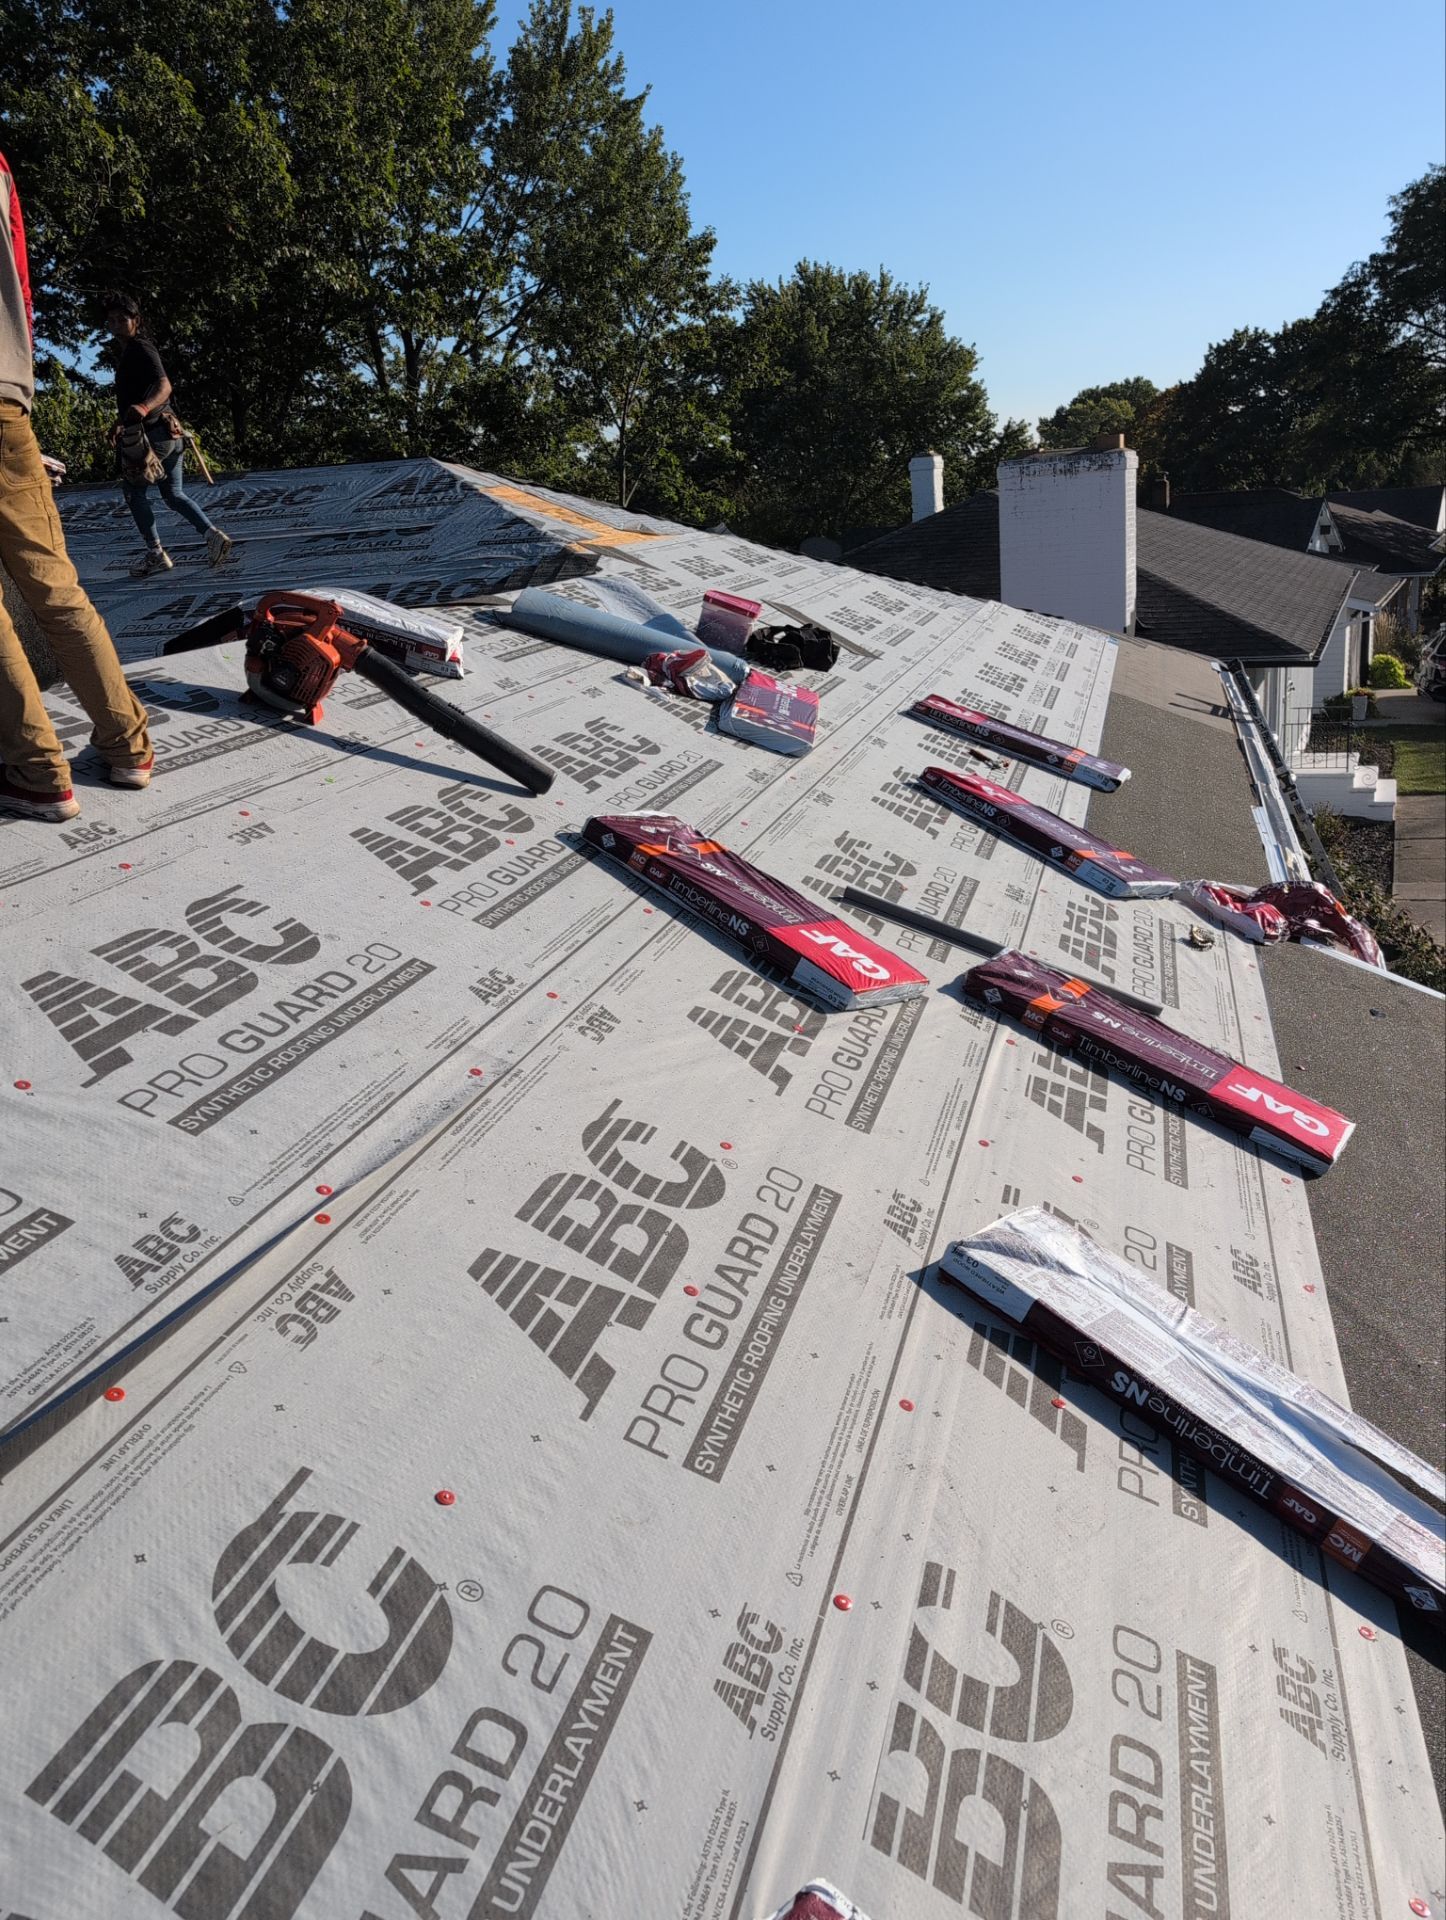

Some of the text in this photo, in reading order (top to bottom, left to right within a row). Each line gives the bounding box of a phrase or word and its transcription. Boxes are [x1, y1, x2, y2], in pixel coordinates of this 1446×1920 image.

[531, 716, 661, 794] ABC
[606, 750, 704, 809] PRO GUARD 20
[58, 820, 118, 850] ABC
[227, 821, 276, 847] ABC
[349, 780, 534, 896] ABC
[630, 851, 647, 865] MC
[437, 838, 566, 916] PRO GUARD
[479, 893, 528, 928] SYNTHETIC
[524, 869, 559, 902] ROOFING
[801, 830, 917, 937] ABC
[799, 928, 892, 980] GAF
[1059, 894, 1119, 984] ABC
[20, 884, 321, 1089] ABC
[467, 967, 517, 1006] ABC
[1022, 1007, 1045, 1025] MC
[117, 1053, 228, 1117] PRO
[217, 971, 357, 1054] GUARD
[346, 942, 402, 974] 20
[177, 960, 430, 1133] SYNTHETIC ROOFING UNDERLAYMENT
[577, 1004, 621, 1045] ABC
[687, 968, 828, 1096] AB
[805, 1007, 889, 1121] PRO GUARD
[851, 1082, 882, 1131] SYNTHETIC
[876, 1047, 899, 1088] ROOFING
[1228, 1082, 1330, 1138] GAF
[1127, 1128, 1156, 1177] PRO
[883, 1187, 925, 1247] ABC
[912, 1227, 930, 1250] Supply
[114, 1211, 201, 1292] ABC
[143, 1261, 186, 1297] Supply
[180, 1244, 203, 1265] Co.
[286, 1259, 326, 1293] Supply
[467, 1097, 727, 1422] ABC
[964, 1254, 980, 1269] 03
[1124, 1225, 1157, 1271] 20
[1231, 1243, 1262, 1300] ABC
[271, 1289, 292, 1309] Co.
[275, 1266, 355, 1352] ABC
[623, 1165, 803, 1459] PRO GUARD 20
[694, 1366, 752, 1474] SYNTHETIC
[744, 1299, 787, 1371] ROOFING
[779, 1186, 834, 1305] UNDERLAYMENT
[98, 1421, 152, 1473] OVERLAP LINE
[1118, 1411, 1161, 1508] PRO
[44, 1497, 74, 1526] LÍNEA
[835, 1487, 850, 1516] OVERLAP
[1281, 1493, 1319, 1524] GAF
[1326, 1530, 1364, 1563] MC
[23, 1465, 455, 1920] BC
[714, 1602, 788, 1740] ABC
[1273, 1634, 1328, 1760] ABC
[756, 1686, 793, 1742] Supply
[776, 1661, 797, 1686] Co.
[1324, 1693, 1337, 1712] Co.
[360, 1584, 591, 1920] ARD 20
[491, 1621, 640, 1914] UNDERLAYMENT
[1331, 1716, 1346, 1762] Supply
[1106, 1623, 1165, 1920] ARD 20
[1186, 1658, 1218, 1912] UNDERLAYMENT
[702, 1835, 715, 1861] ASTM
[708, 1815, 721, 1836] D226
[688, 1862, 706, 1901] Following:
[697, 1826, 729, 1912] D4869 Type ASTM
[722, 1862, 736, 1891] A123.3
[735, 1820, 749, 1847] A220.1
